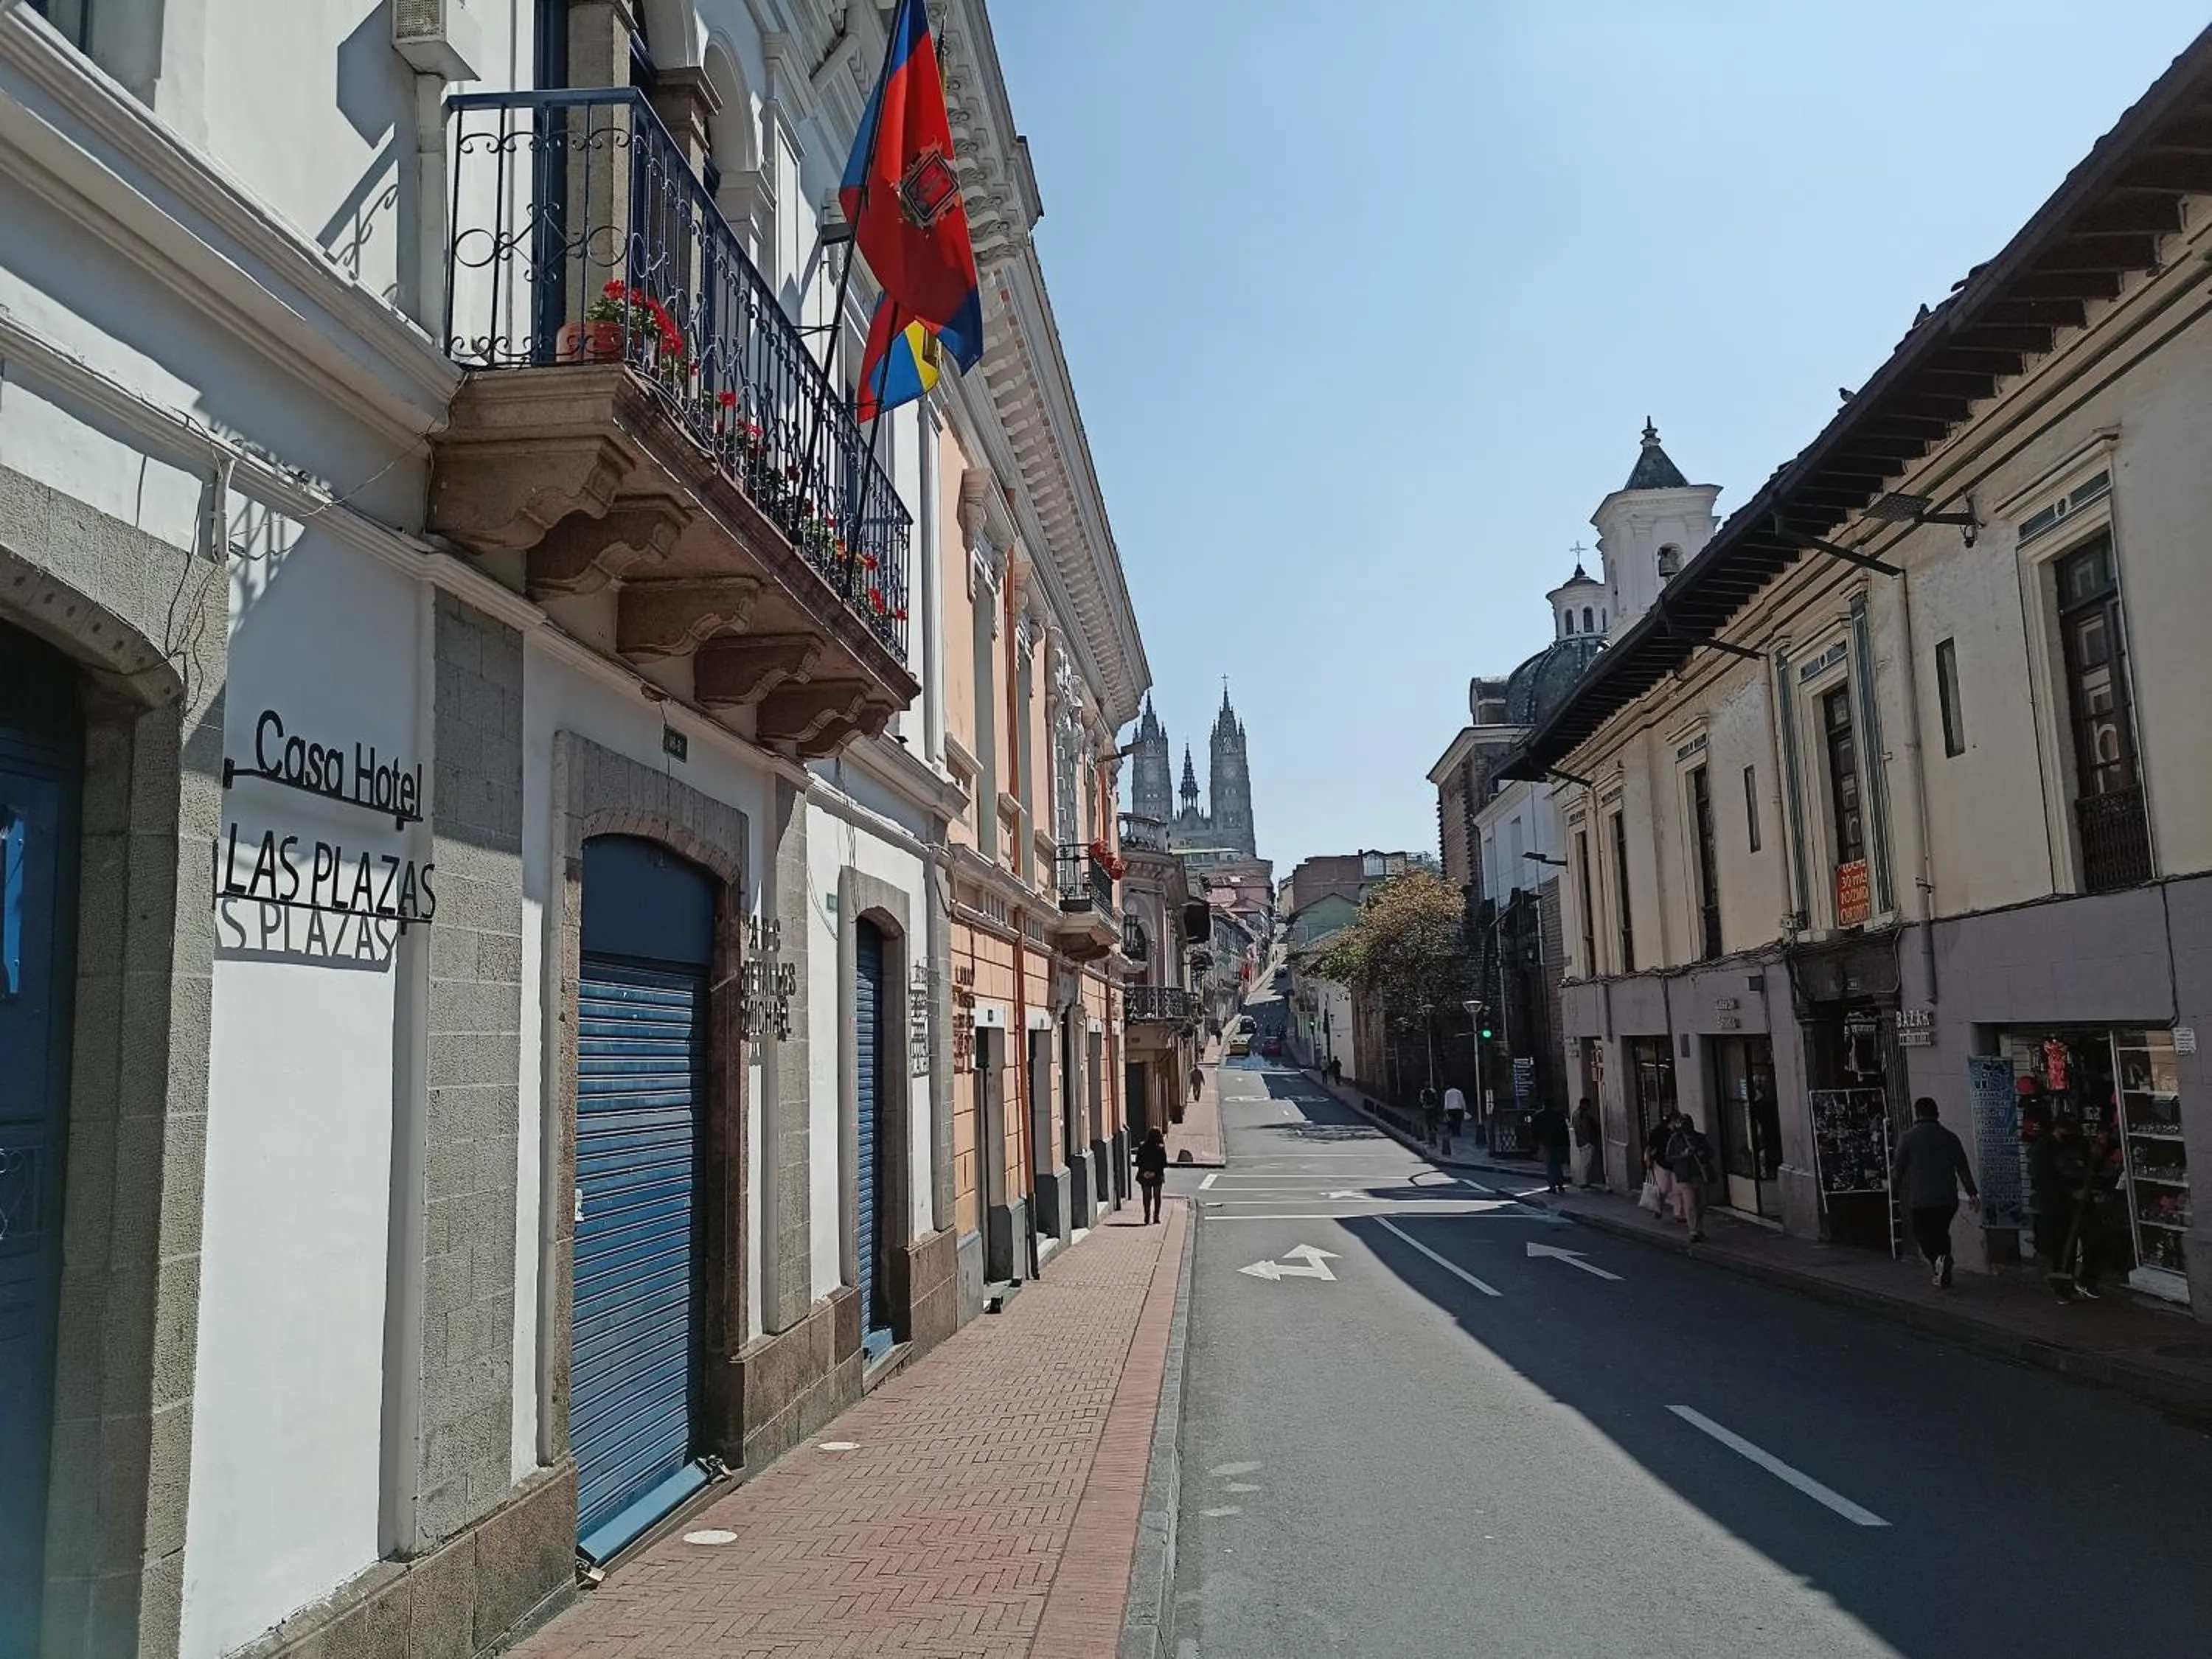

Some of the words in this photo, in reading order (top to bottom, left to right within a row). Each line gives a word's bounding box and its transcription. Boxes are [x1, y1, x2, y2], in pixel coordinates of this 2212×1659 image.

[256, 709, 344, 795] Casa
[355, 742, 422, 818] Hotel
[225, 823, 300, 901] LAS
[311, 841, 437, 919] PLAZAS
